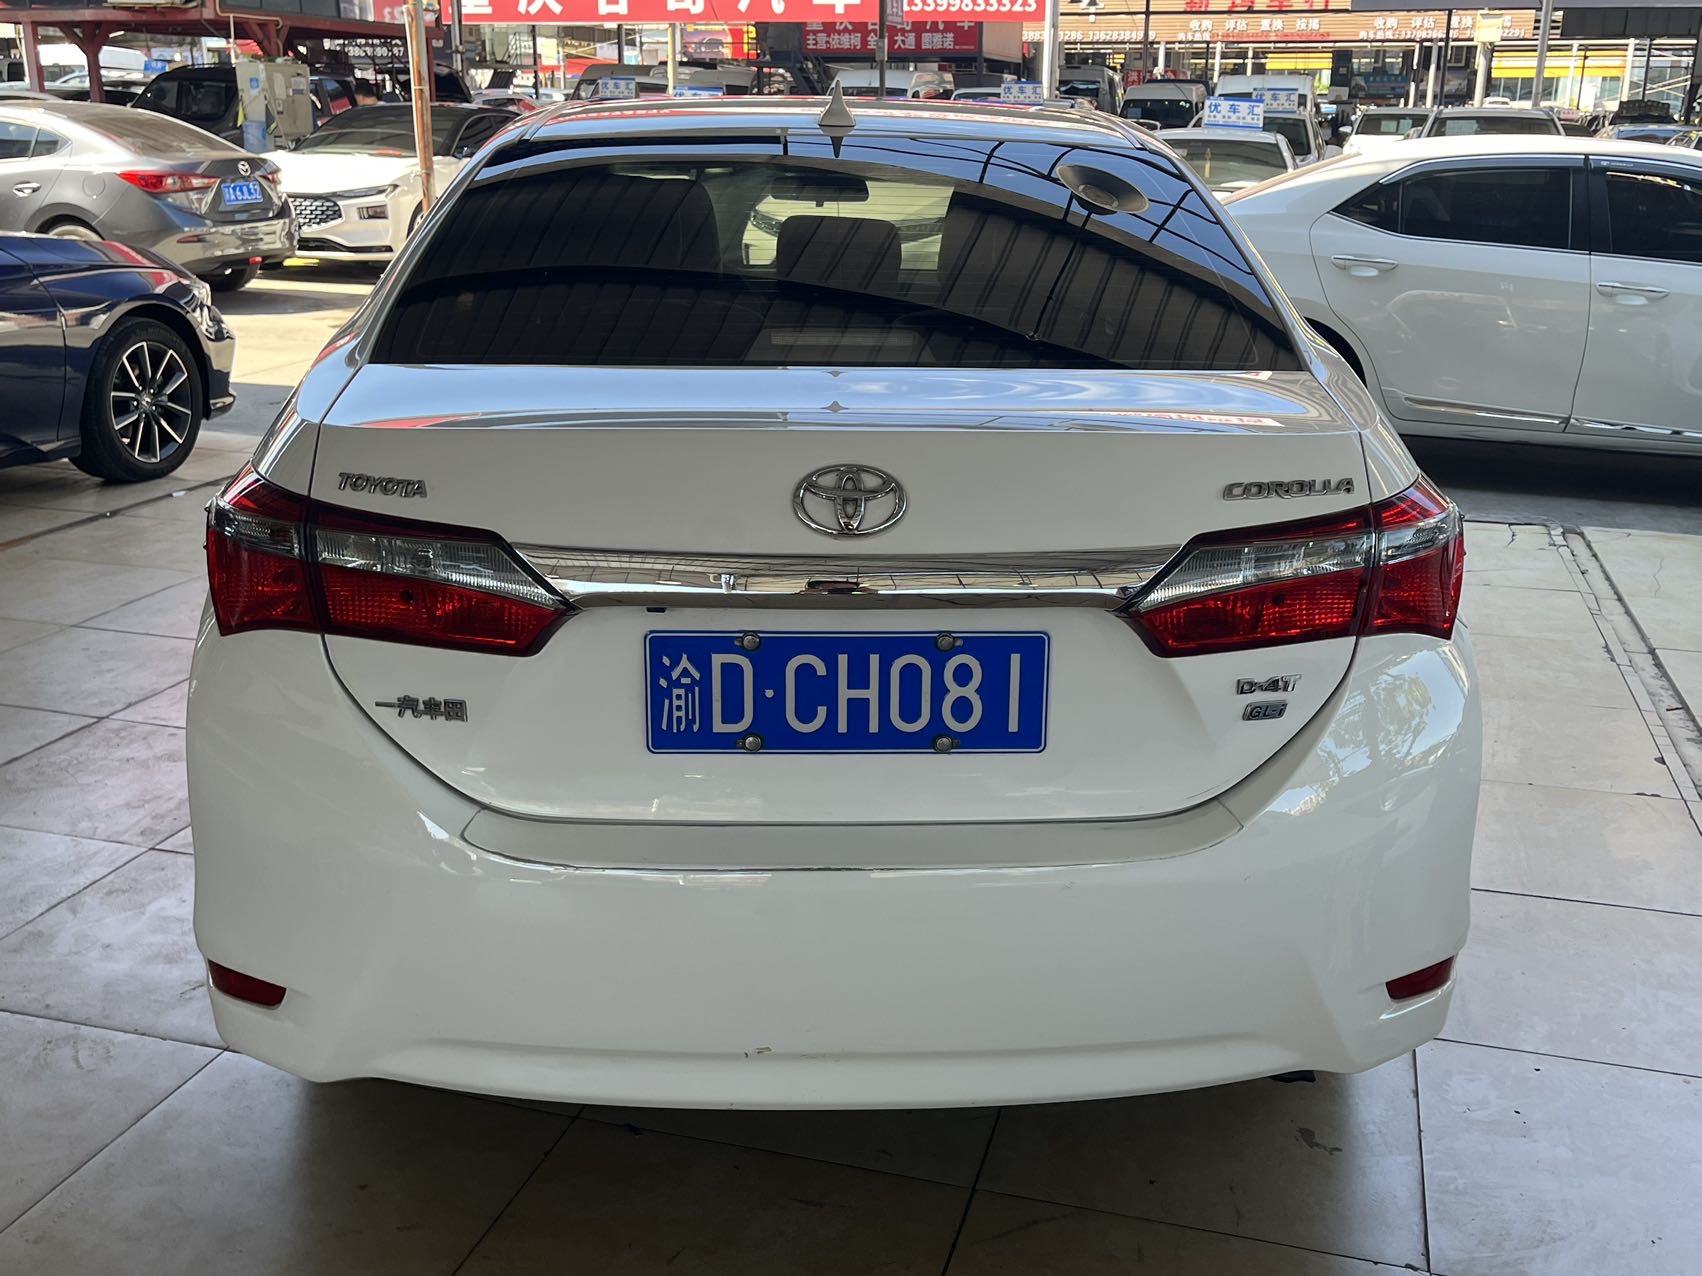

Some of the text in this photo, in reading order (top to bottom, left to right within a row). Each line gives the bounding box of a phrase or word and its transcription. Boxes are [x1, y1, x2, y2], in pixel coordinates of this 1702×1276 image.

[1208, 102, 1261, 116] 优车汇
[338, 472, 427, 498] TOYOTA
[1223, 478, 1354, 501] COROLLA
[1236, 674, 1302, 695] D-4T
[375, 695, 468, 722] 一汽丰田
